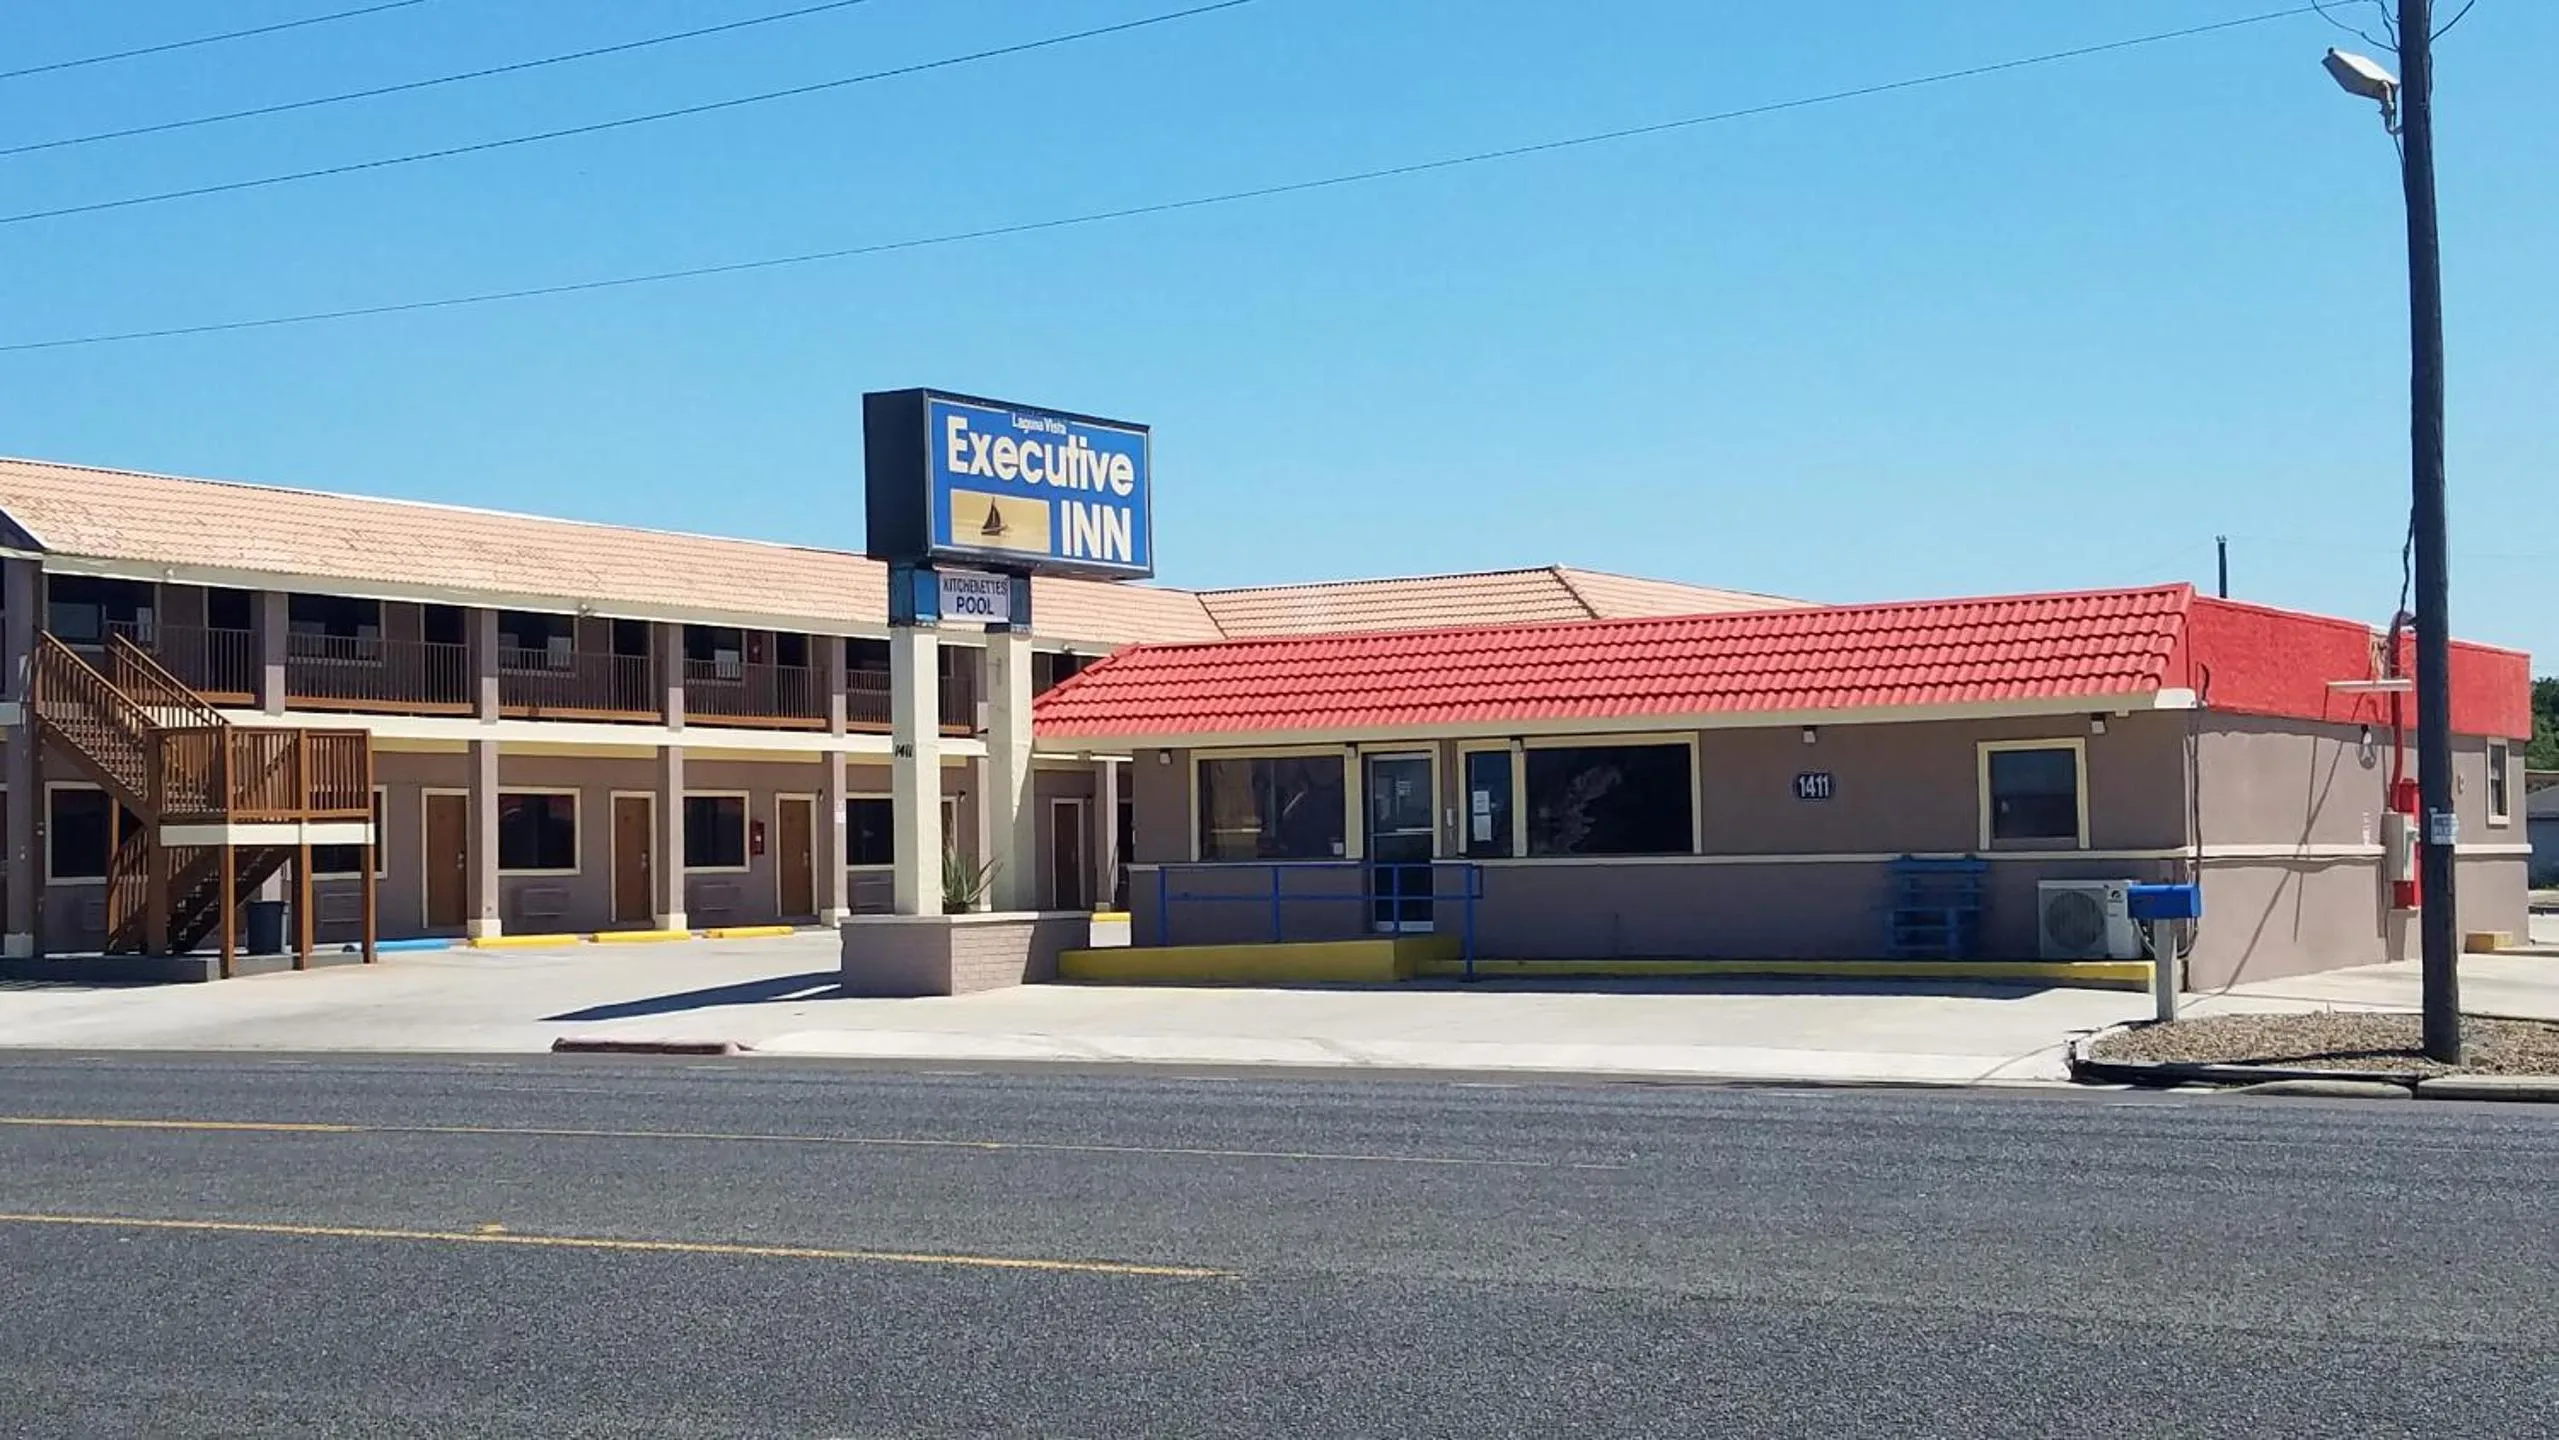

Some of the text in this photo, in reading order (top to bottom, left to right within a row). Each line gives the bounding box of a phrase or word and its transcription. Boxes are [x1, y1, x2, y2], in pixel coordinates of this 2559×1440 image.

[1011, 411, 1067, 435] Laguna Vista
[947, 415, 1134, 496] Executive
[1060, 500, 1133, 562] INN
[943, 577, 1008, 596] KITCHENETTES
[956, 596, 994, 615] POOL
[1799, 775, 1829, 797] 1411
